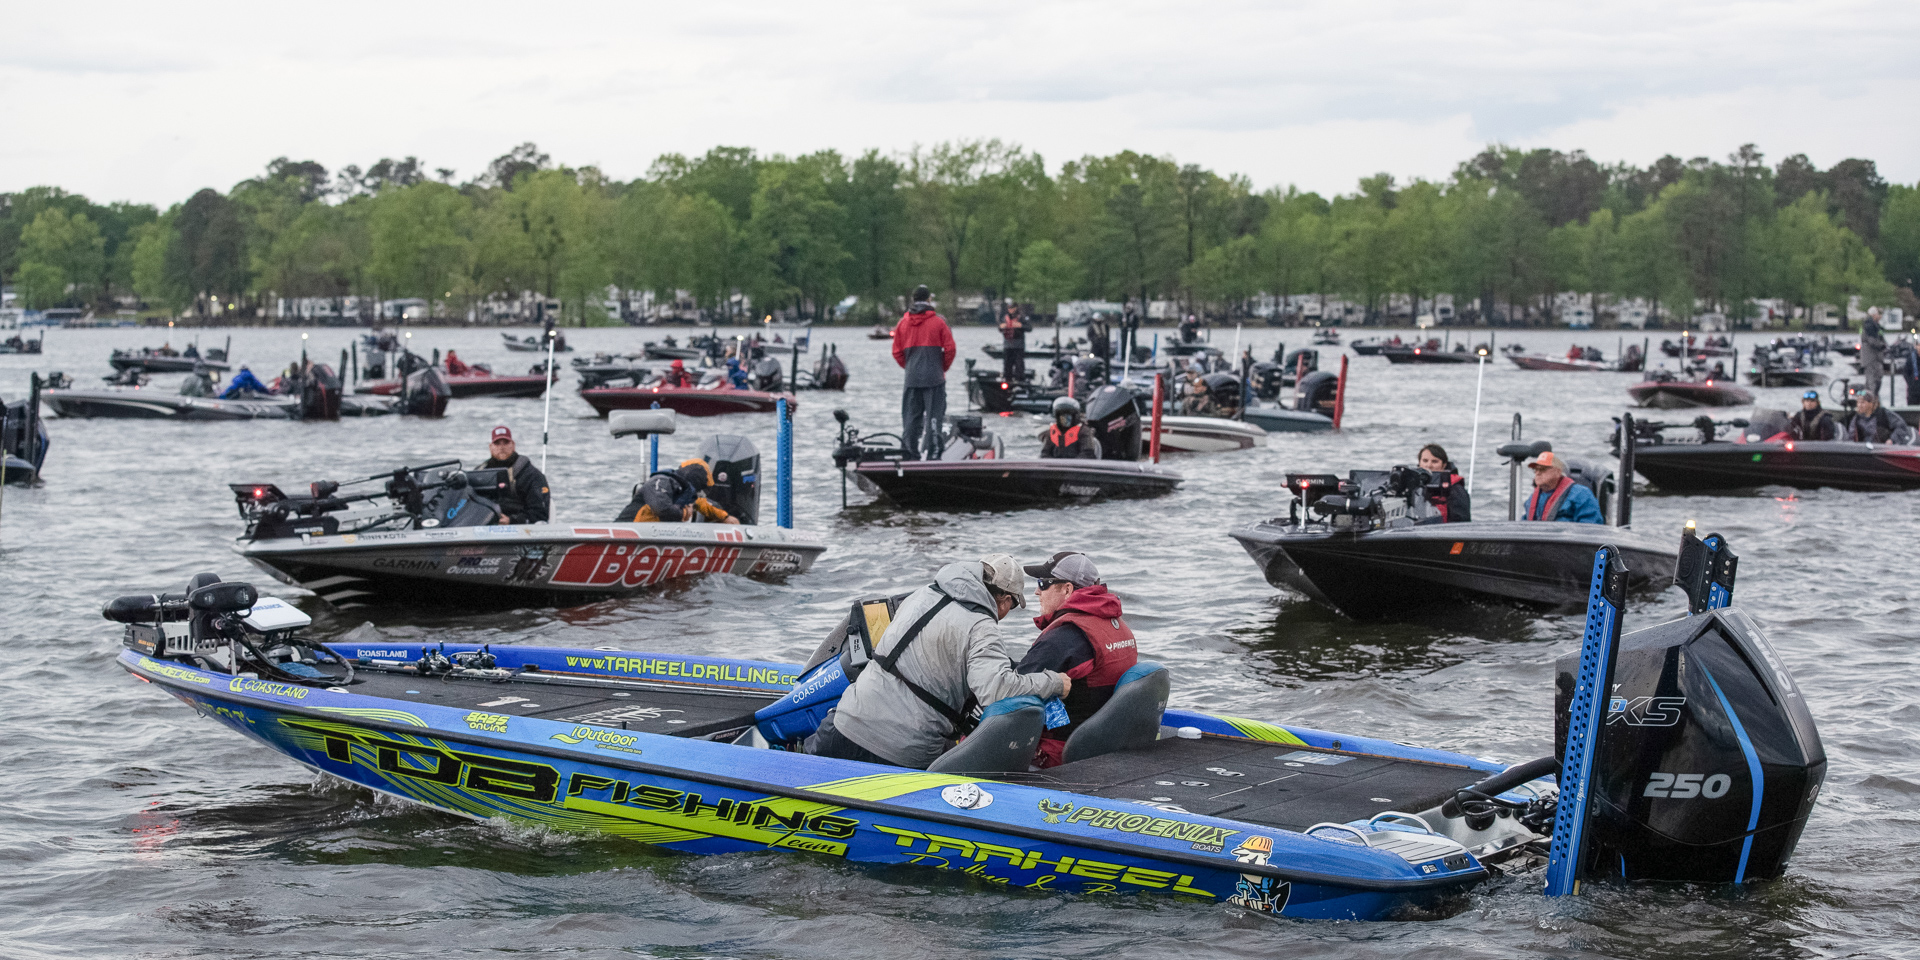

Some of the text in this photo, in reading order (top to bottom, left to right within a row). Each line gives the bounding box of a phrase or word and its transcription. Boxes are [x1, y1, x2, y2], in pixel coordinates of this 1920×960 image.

[373, 558, 440, 570] GARMIN
[587, 543, 743, 587] Benelli
[244, 680, 310, 699] COASTLAND
[792, 669, 841, 704] COASTLAND
[466, 712, 510, 726] BASS
[571, 726, 638, 747] iOutdoor
[277, 718, 860, 840] TDB FISHING
[1643, 772, 1732, 799] 250
[1066, 806, 1242, 847] PHOENIX
[767, 829, 838, 853] Team
[1191, 843, 1222, 853] BOATS
[873, 824, 1217, 898] TARHEEL
